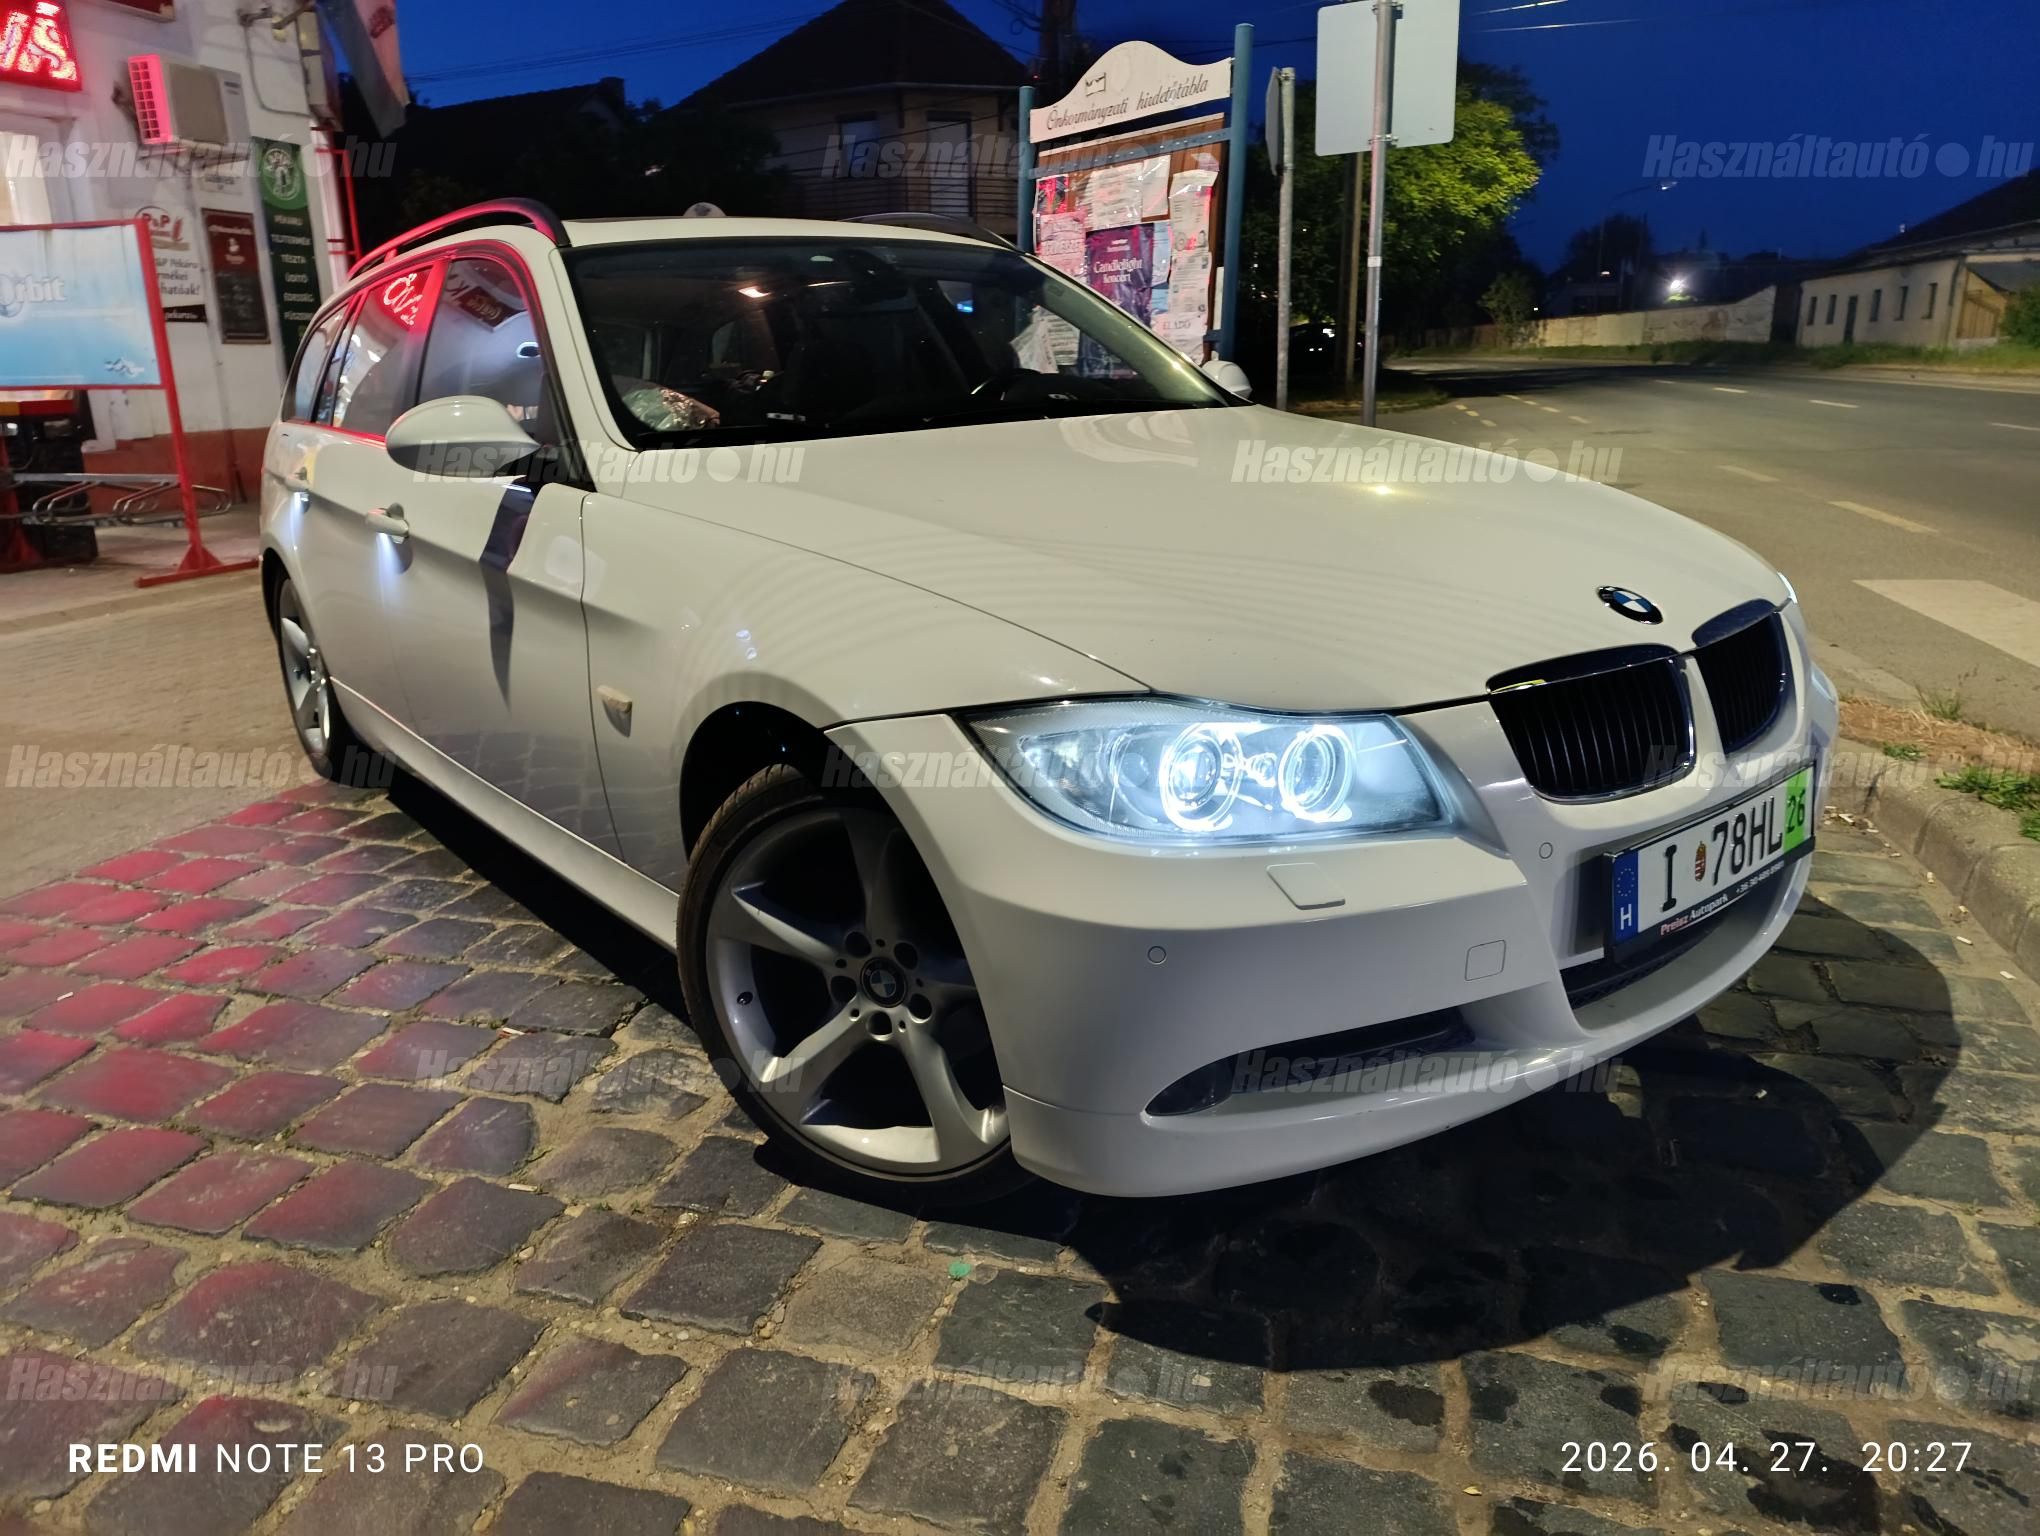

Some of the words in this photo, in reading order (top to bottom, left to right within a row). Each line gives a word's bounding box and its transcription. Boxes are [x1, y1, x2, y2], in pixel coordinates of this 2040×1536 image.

[1093, 257, 1143, 274] Candlelight
[1711, 795, 1784, 887] 78HL
[1786, 788, 1807, 833] 26
[1620, 903, 1632, 930] H
